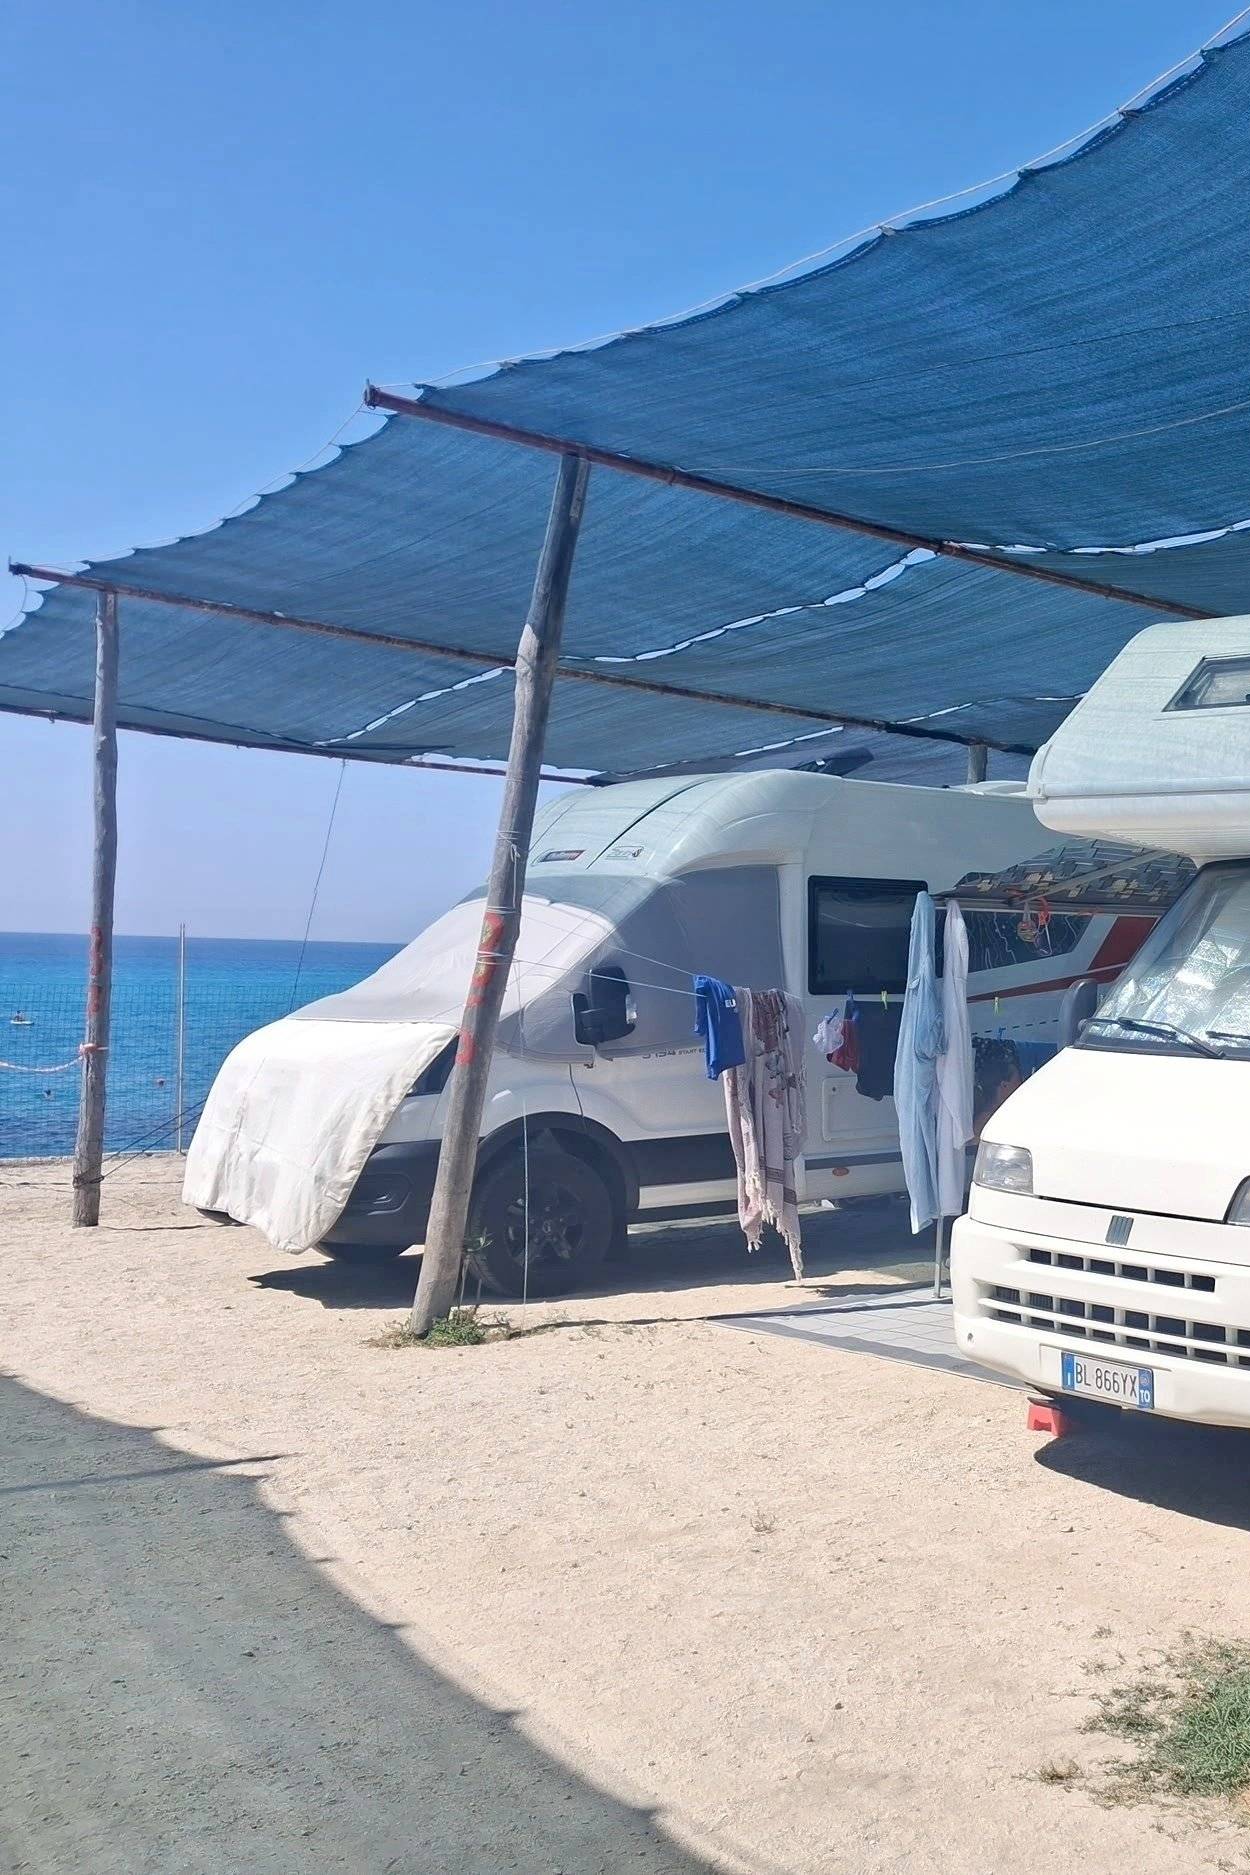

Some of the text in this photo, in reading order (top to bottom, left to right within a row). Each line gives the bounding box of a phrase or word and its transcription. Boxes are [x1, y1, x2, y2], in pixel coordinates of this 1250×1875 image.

[1075, 1363, 1091, 1386] BL
[1095, 1368, 1138, 1398] 866YX
[1140, 1389, 1151, 1403] TO
